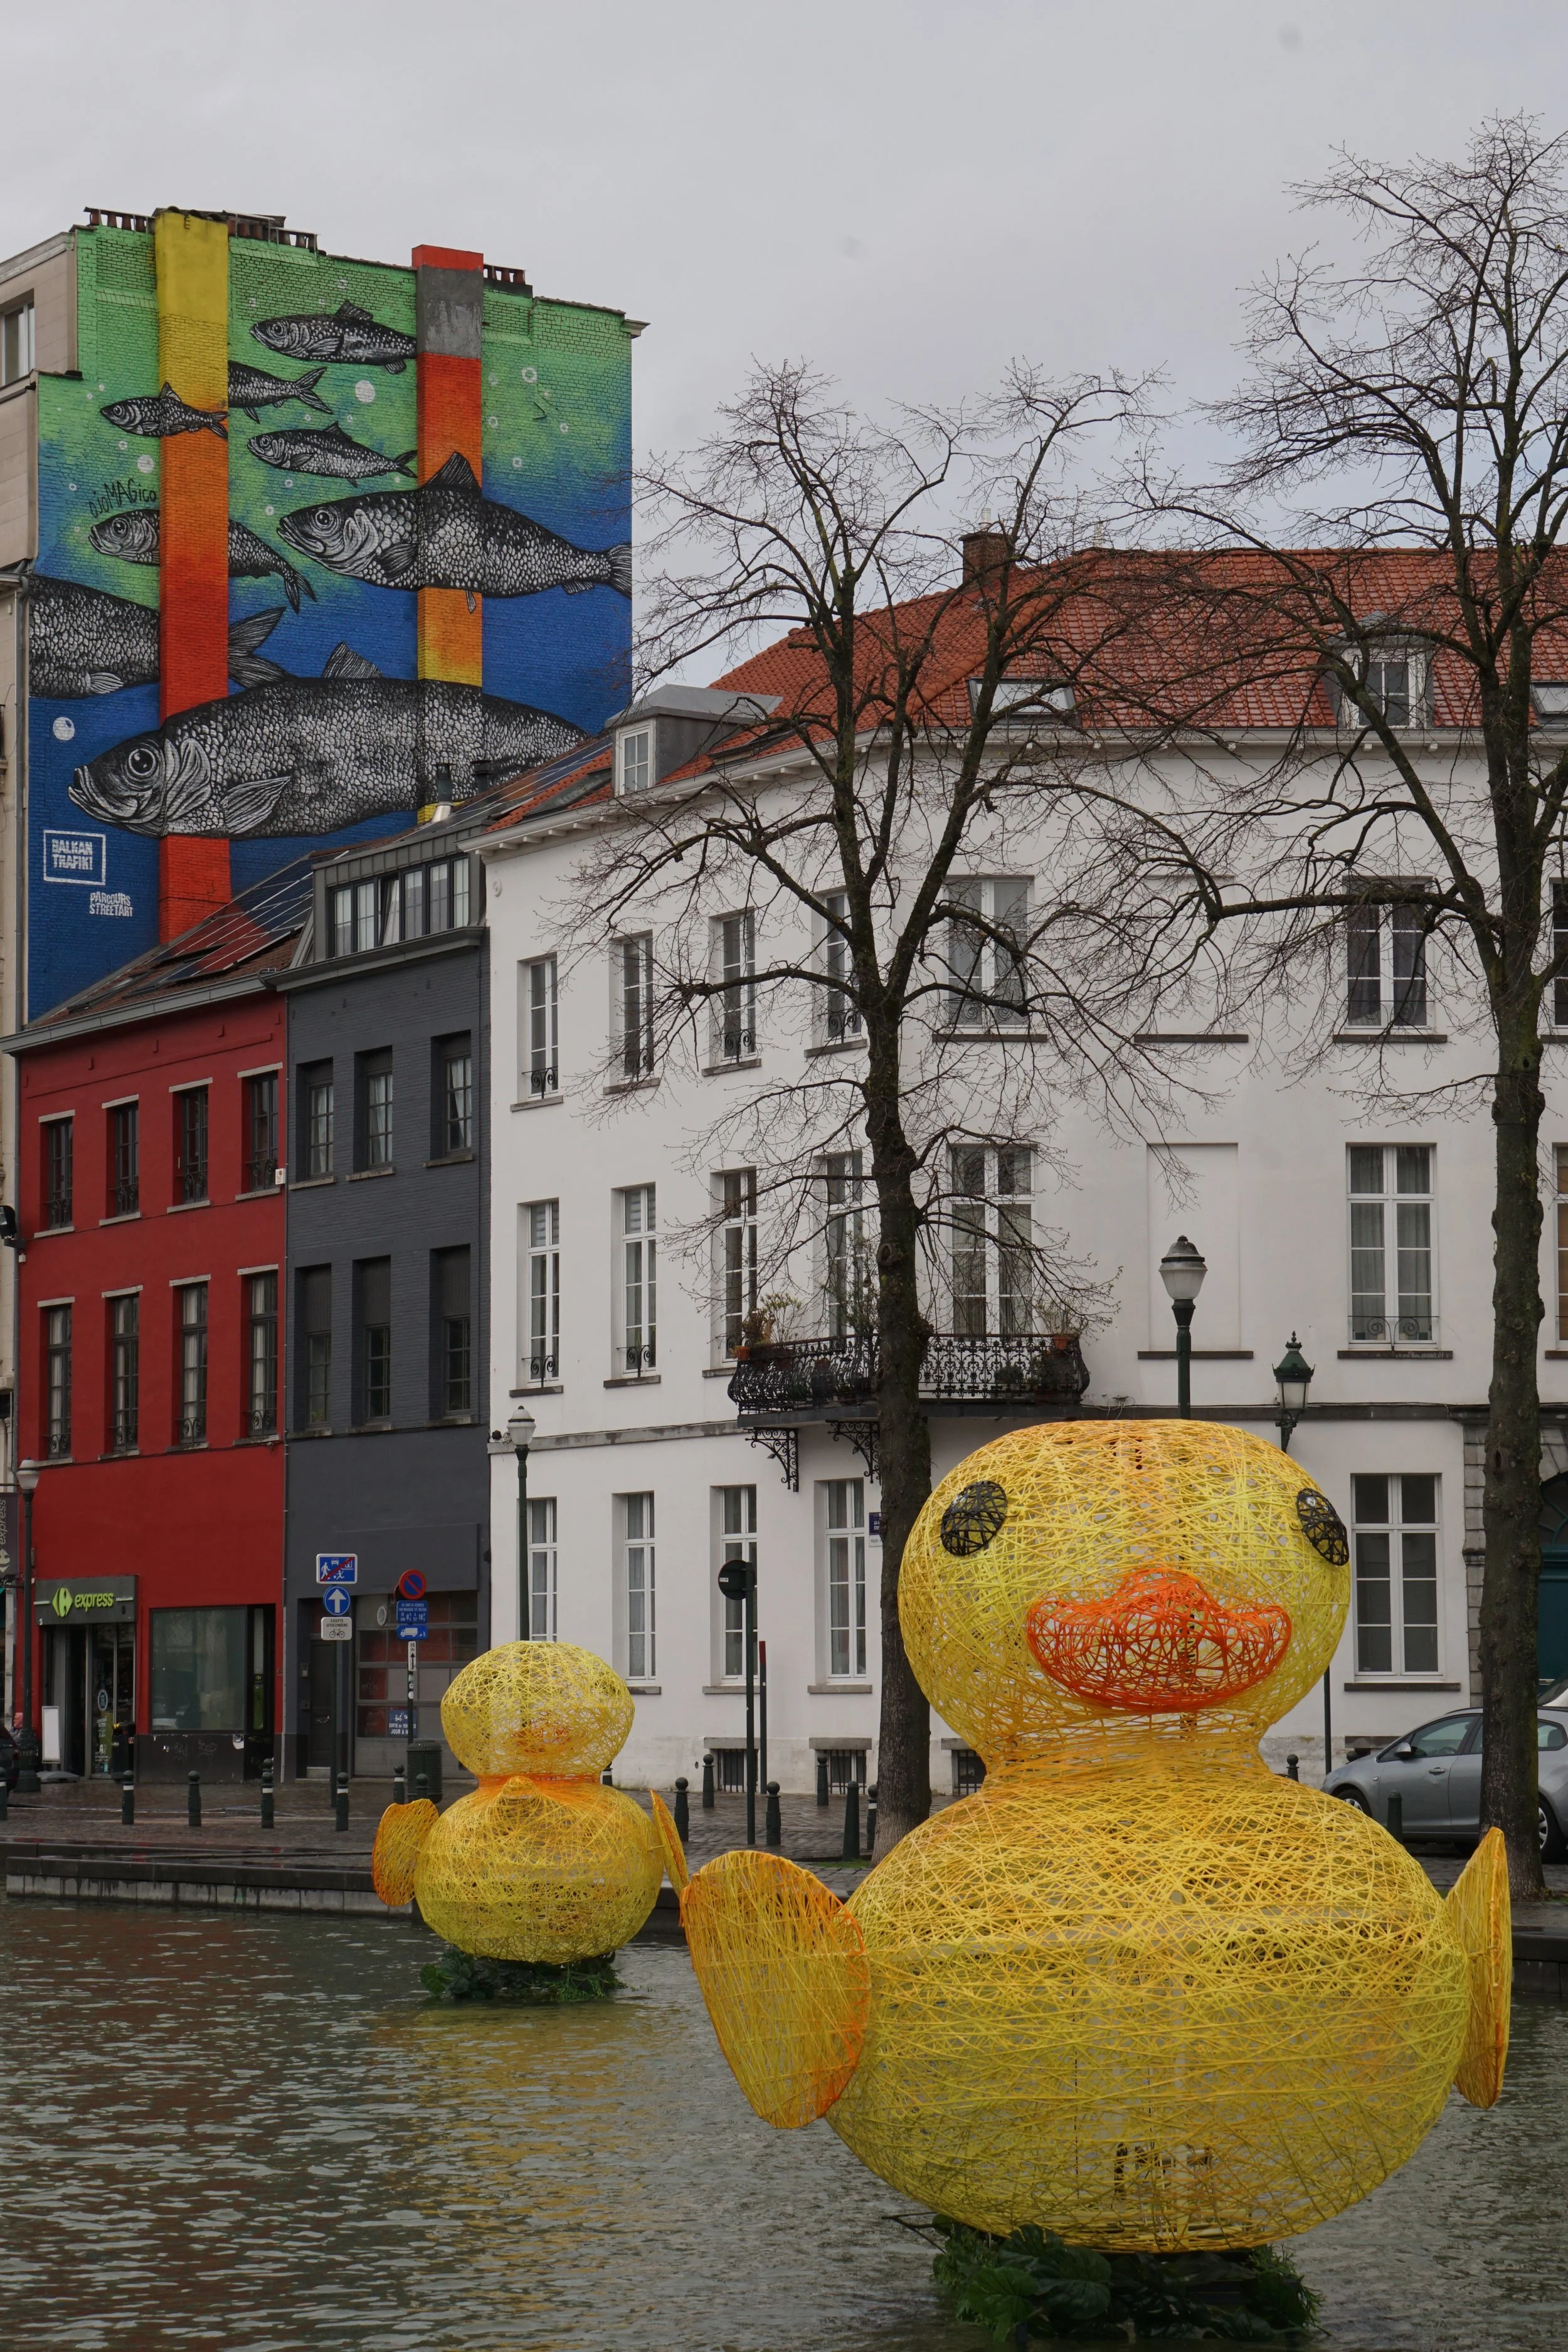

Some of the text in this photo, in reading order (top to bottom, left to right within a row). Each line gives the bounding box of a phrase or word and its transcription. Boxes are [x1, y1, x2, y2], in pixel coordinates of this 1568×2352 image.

[51, 839, 93, 856] BALKAN
[51, 854, 93, 871] TRAFIK!
[90, 891, 131, 906] PARCOURS
[89, 902, 134, 917] STREETART
[74, 1592, 115, 1613] express
